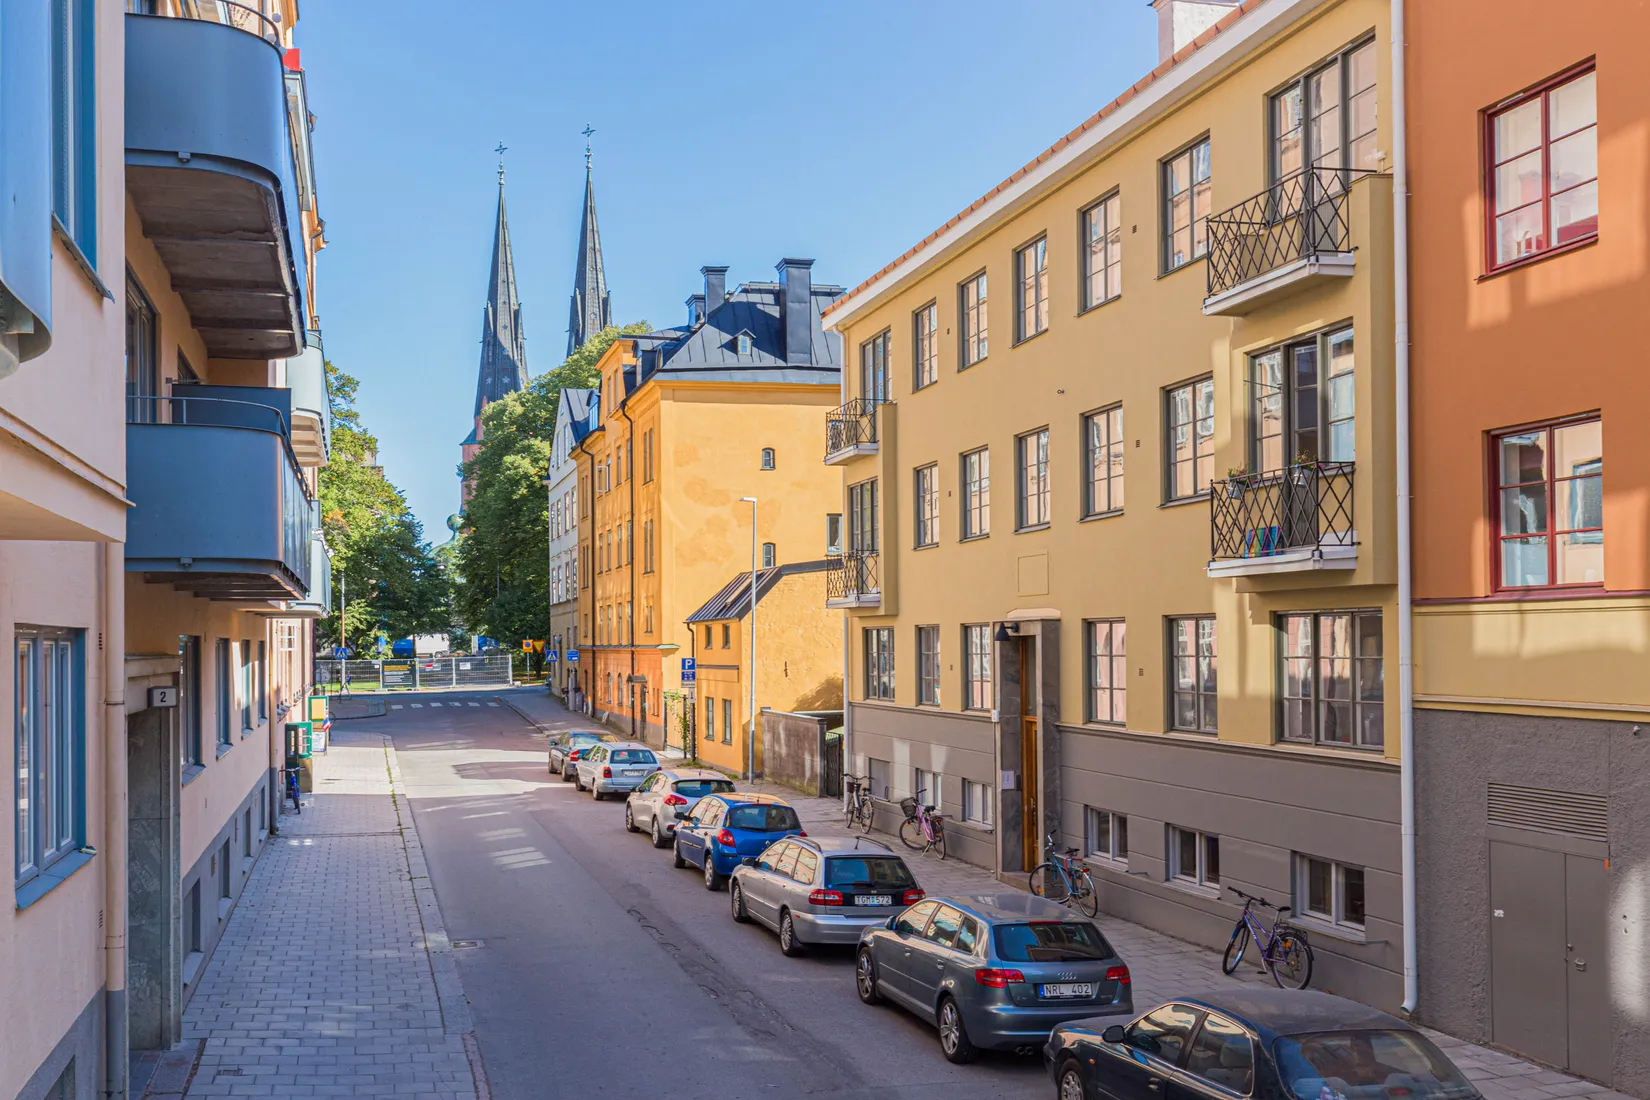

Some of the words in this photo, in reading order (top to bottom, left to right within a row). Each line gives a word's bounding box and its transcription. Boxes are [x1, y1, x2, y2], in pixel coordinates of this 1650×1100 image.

[685, 659, 693, 670] P
[160, 691, 167, 703] 2
[875, 895, 891, 904] 572
[1045, 985, 1064, 995] NRL
[1071, 984, 1090, 994] 402
